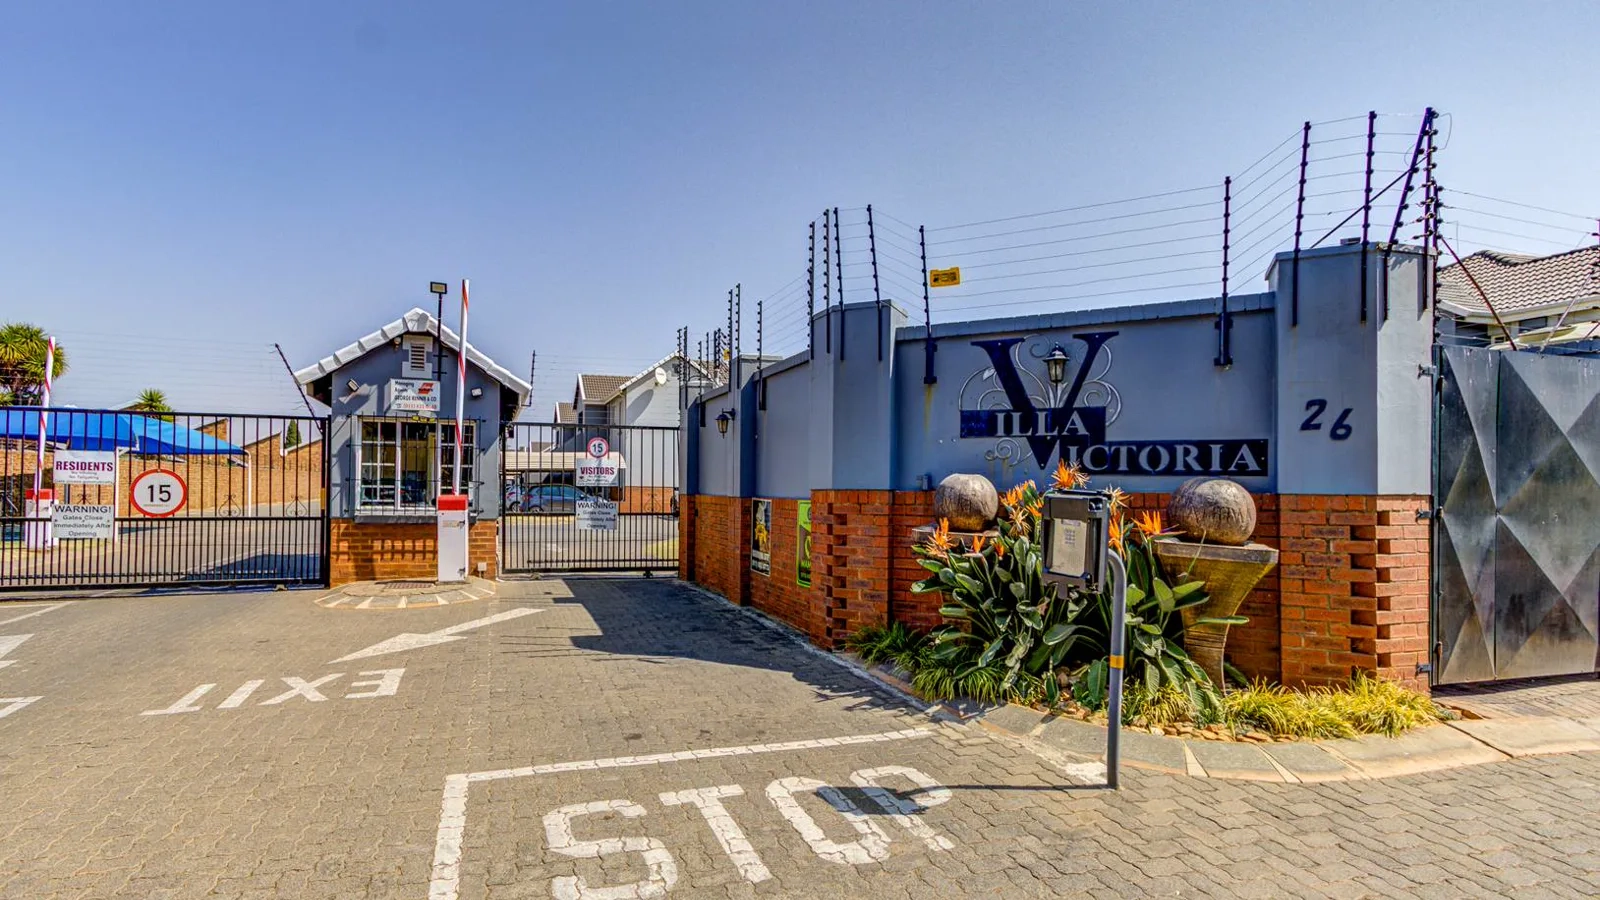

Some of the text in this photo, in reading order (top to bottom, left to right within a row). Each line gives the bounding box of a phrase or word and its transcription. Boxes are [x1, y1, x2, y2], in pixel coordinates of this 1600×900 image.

[1299, 399, 1354, 441] 26
[592, 443, 603, 453] 15
[55, 461, 113, 472] RESIDENTS
[580, 466, 615, 475] VISITORS
[147, 484, 171, 503] 15
[54, 505, 111, 513] WARNING!
[140, 668, 406, 716] EXIT
[542, 765, 955, 900] STOP
